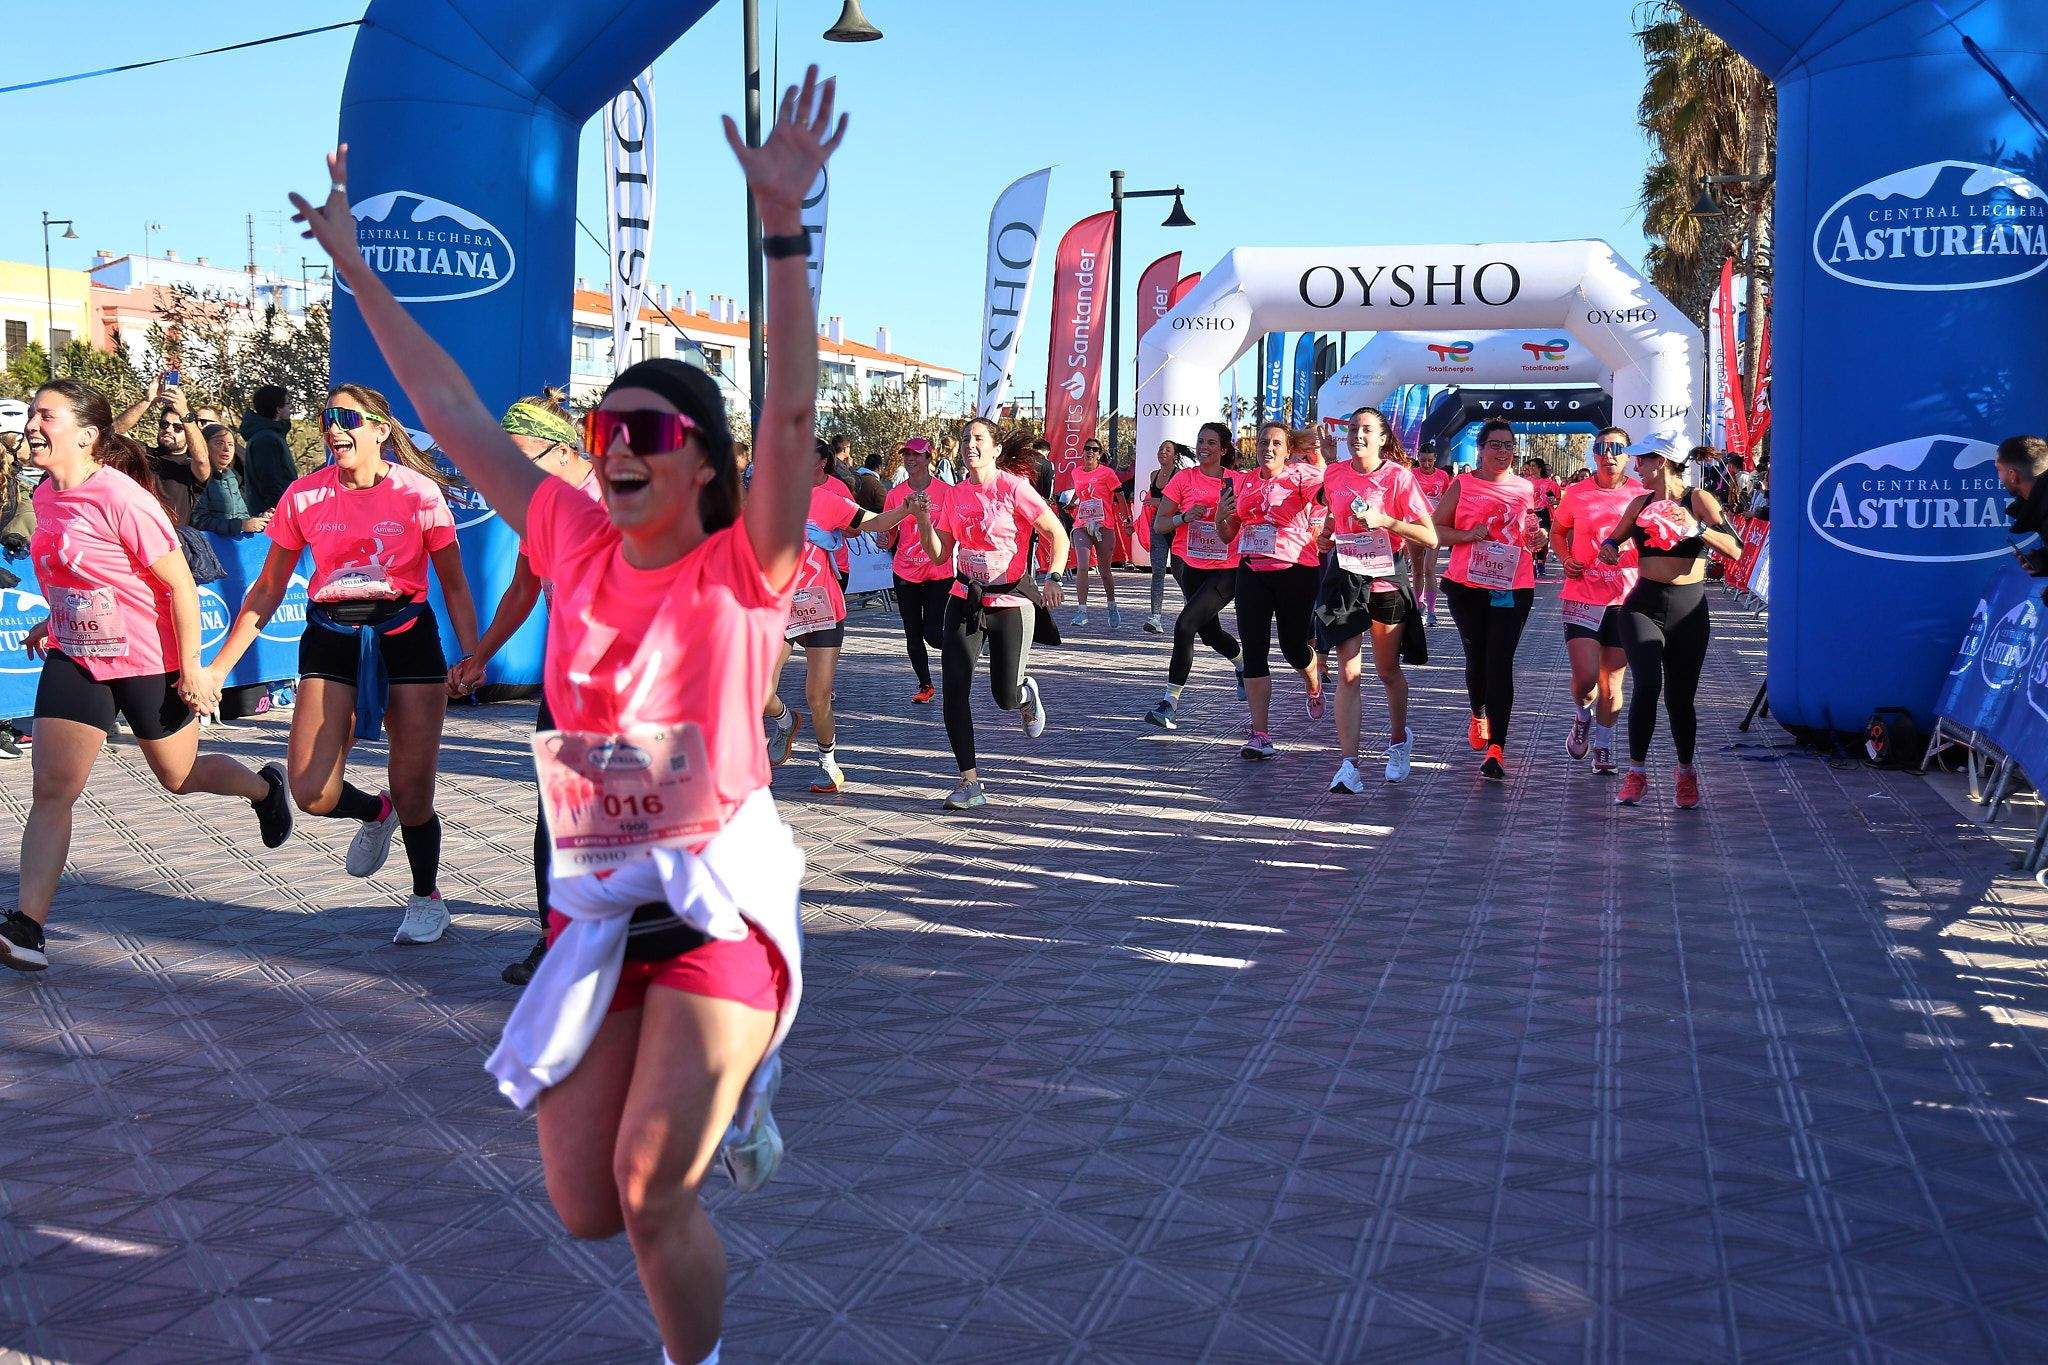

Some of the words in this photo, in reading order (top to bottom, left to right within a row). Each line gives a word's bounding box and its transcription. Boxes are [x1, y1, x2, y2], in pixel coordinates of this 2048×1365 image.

[1869, 206, 1960, 221] CENTRAL
[1970, 204, 2044, 217] LECHERA
[360, 229, 410, 240] ENTRAL
[417, 230, 492, 247] LECHERA
[1828, 215, 2048, 263] ASTURIANA
[359, 244, 499, 280] TURIANA
[1299, 262, 1520, 308] OYSHO
[1068, 248, 1096, 368] Santander
[985, 222, 1037, 415] YSHO
[1587, 309, 1657, 324] OYSHO
[1172, 317, 1235, 331] OYSHO
[1427, 365, 1474, 373] TotalEnergies
[1522, 364, 1570, 372] TotalEnergies
[1142, 403, 1199, 417] OYSHO
[1478, 400, 1581, 410] VOLVO
[1624, 404, 1689, 419] OYSHO
[1058, 404, 1084, 474] Sports
[1862, 480, 1951, 491] CENTRAL
[1962, 479, 2006, 490] LECH
[1822, 483, 2016, 528] ASTURIA
[1200, 537, 1216, 545] 016
[1254, 538, 1268, 546] 016
[1485, 560, 1504, 570] 016
[972, 571, 990, 580] 016
[796, 607, 817, 617] 016
[69, 620, 99, 631] 016
[603, 794, 664, 817] 016
[573, 851, 627, 865] OYSHO
